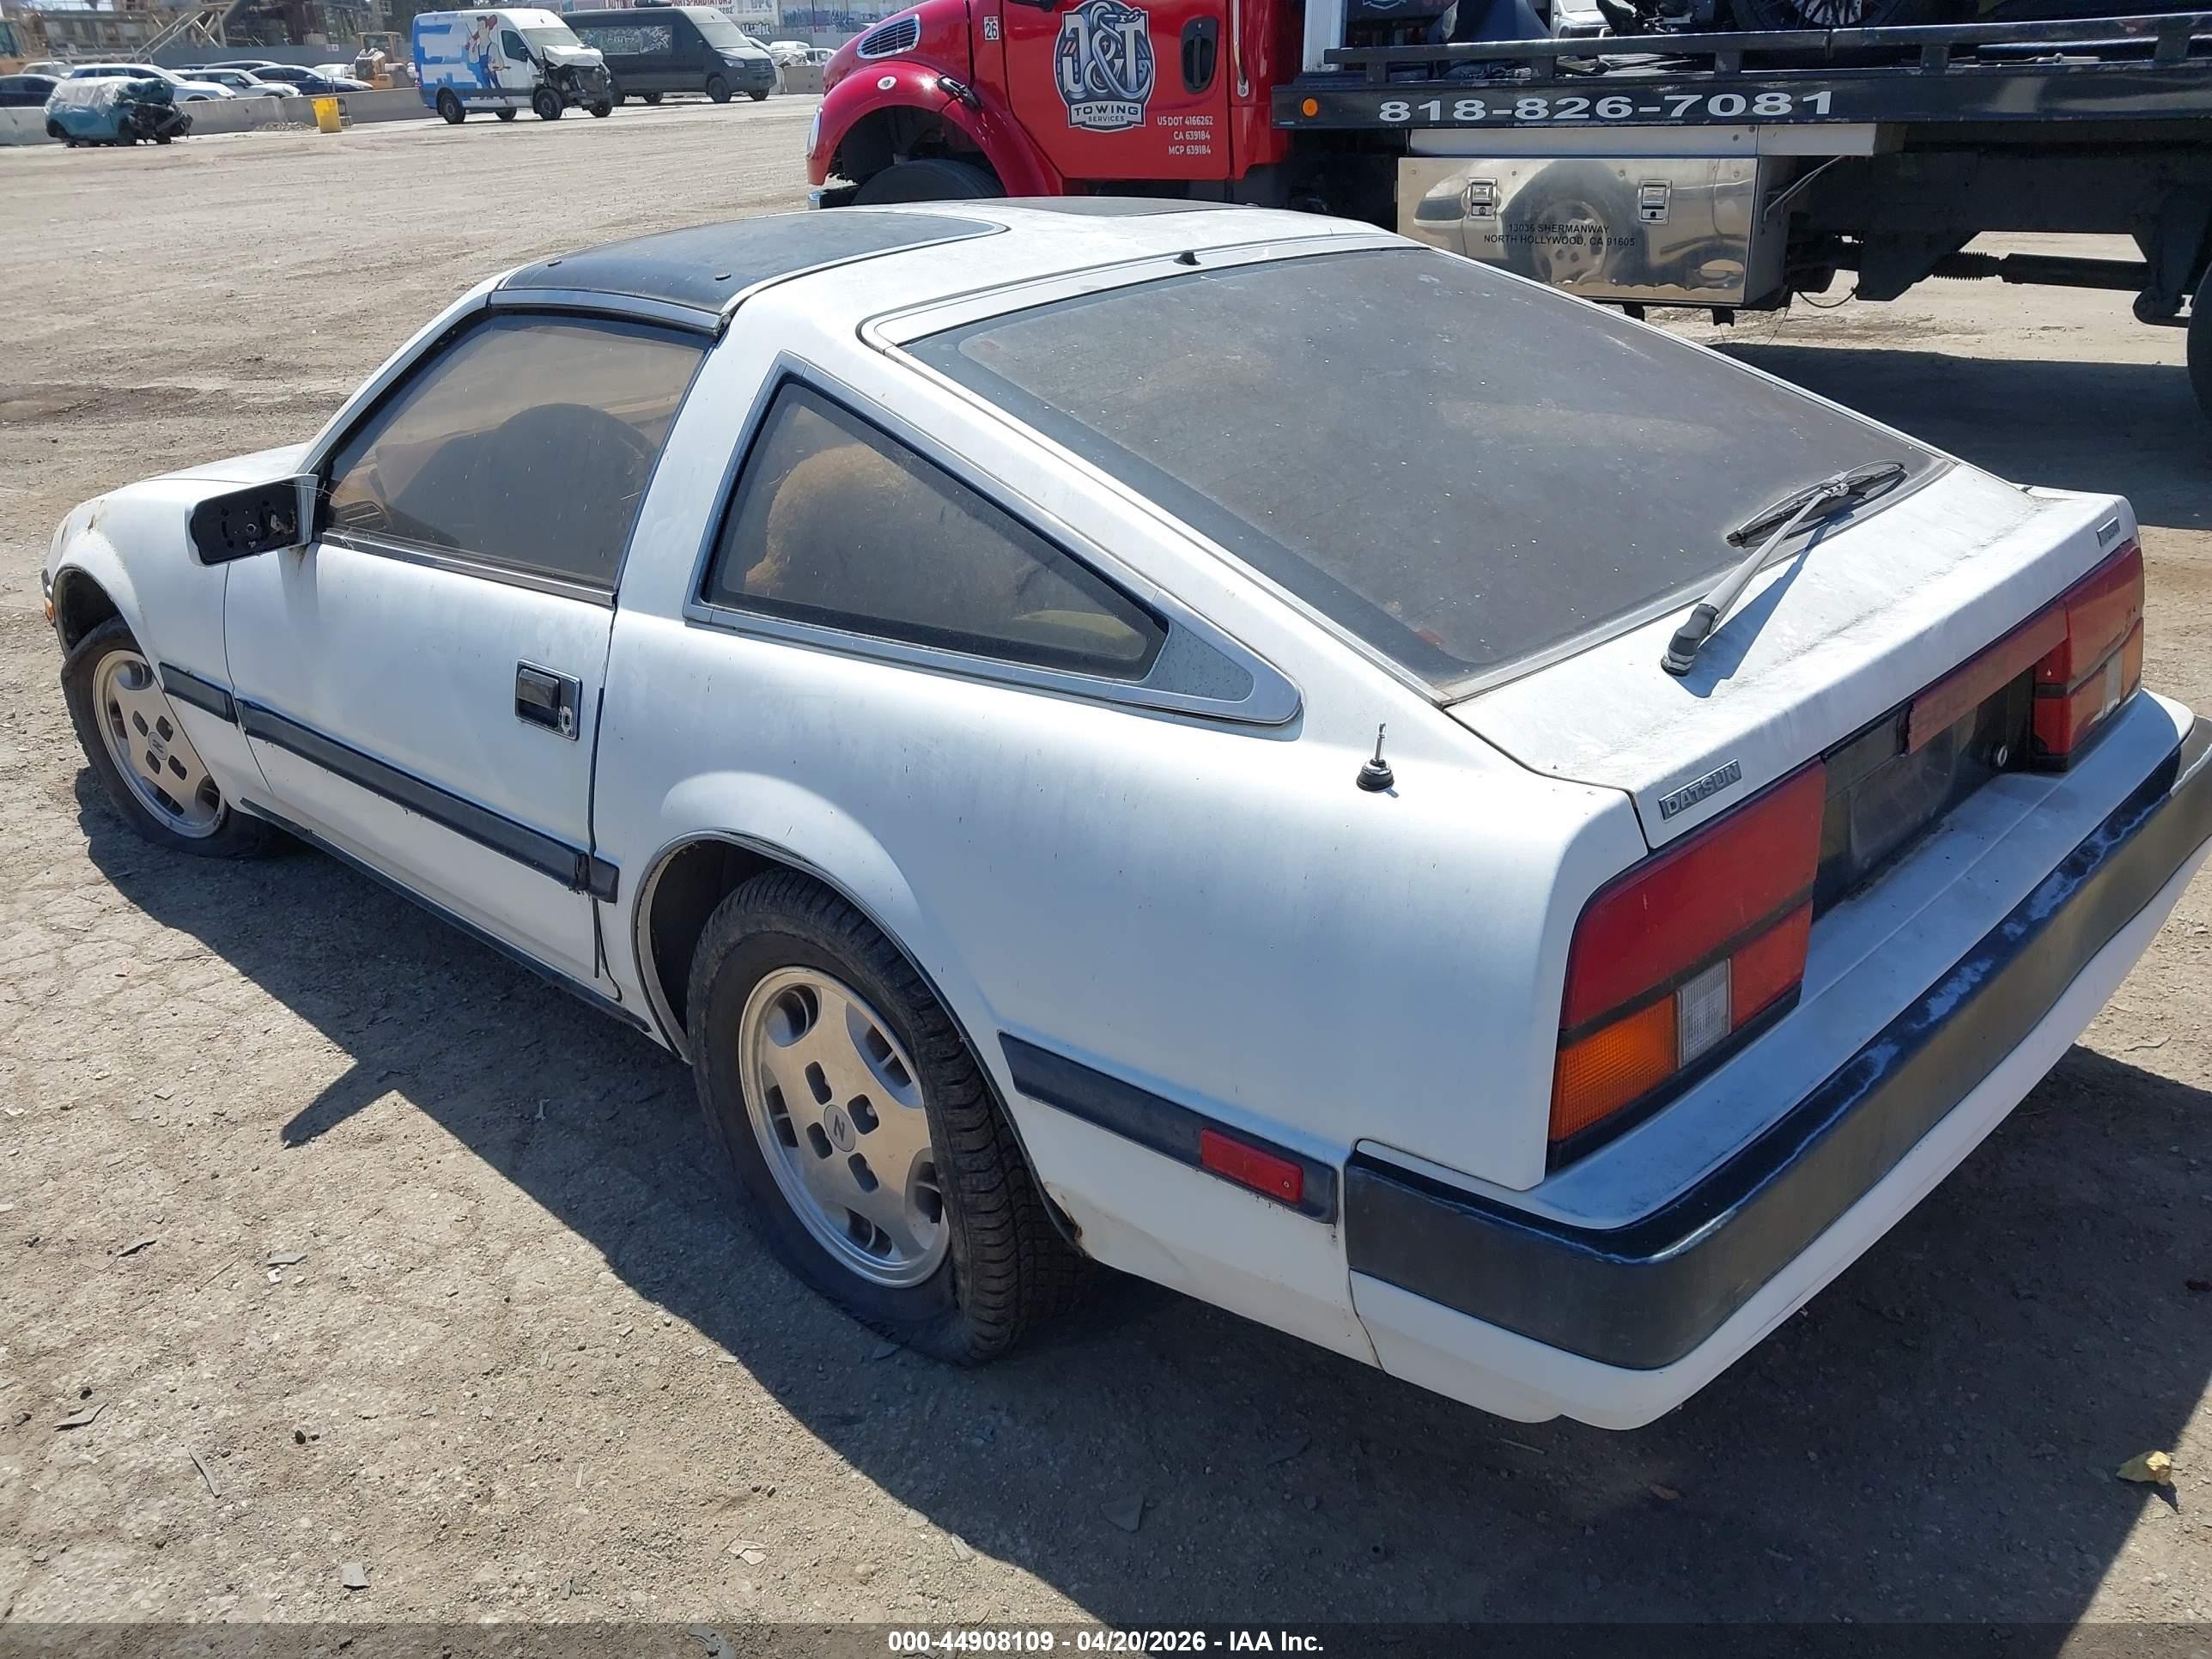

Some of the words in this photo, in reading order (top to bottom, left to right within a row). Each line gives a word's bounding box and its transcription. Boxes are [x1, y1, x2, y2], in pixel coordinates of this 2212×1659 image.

[986, 22, 998, 39] 26
[1073, 105, 1139, 116] TOWING
[1379, 91, 1832, 121] 818-826-7081
[1173, 131, 1184, 140] CA
[1168, 145, 1185, 155] MCP
[1484, 234, 1517, 243] NORTH
[1520, 235, 1586, 246] HOLLYWOOD,
[1589, 237, 1604, 246] CA
[1607, 237, 1635, 246] 91605
[1664, 762, 1742, 815] DATSUN
